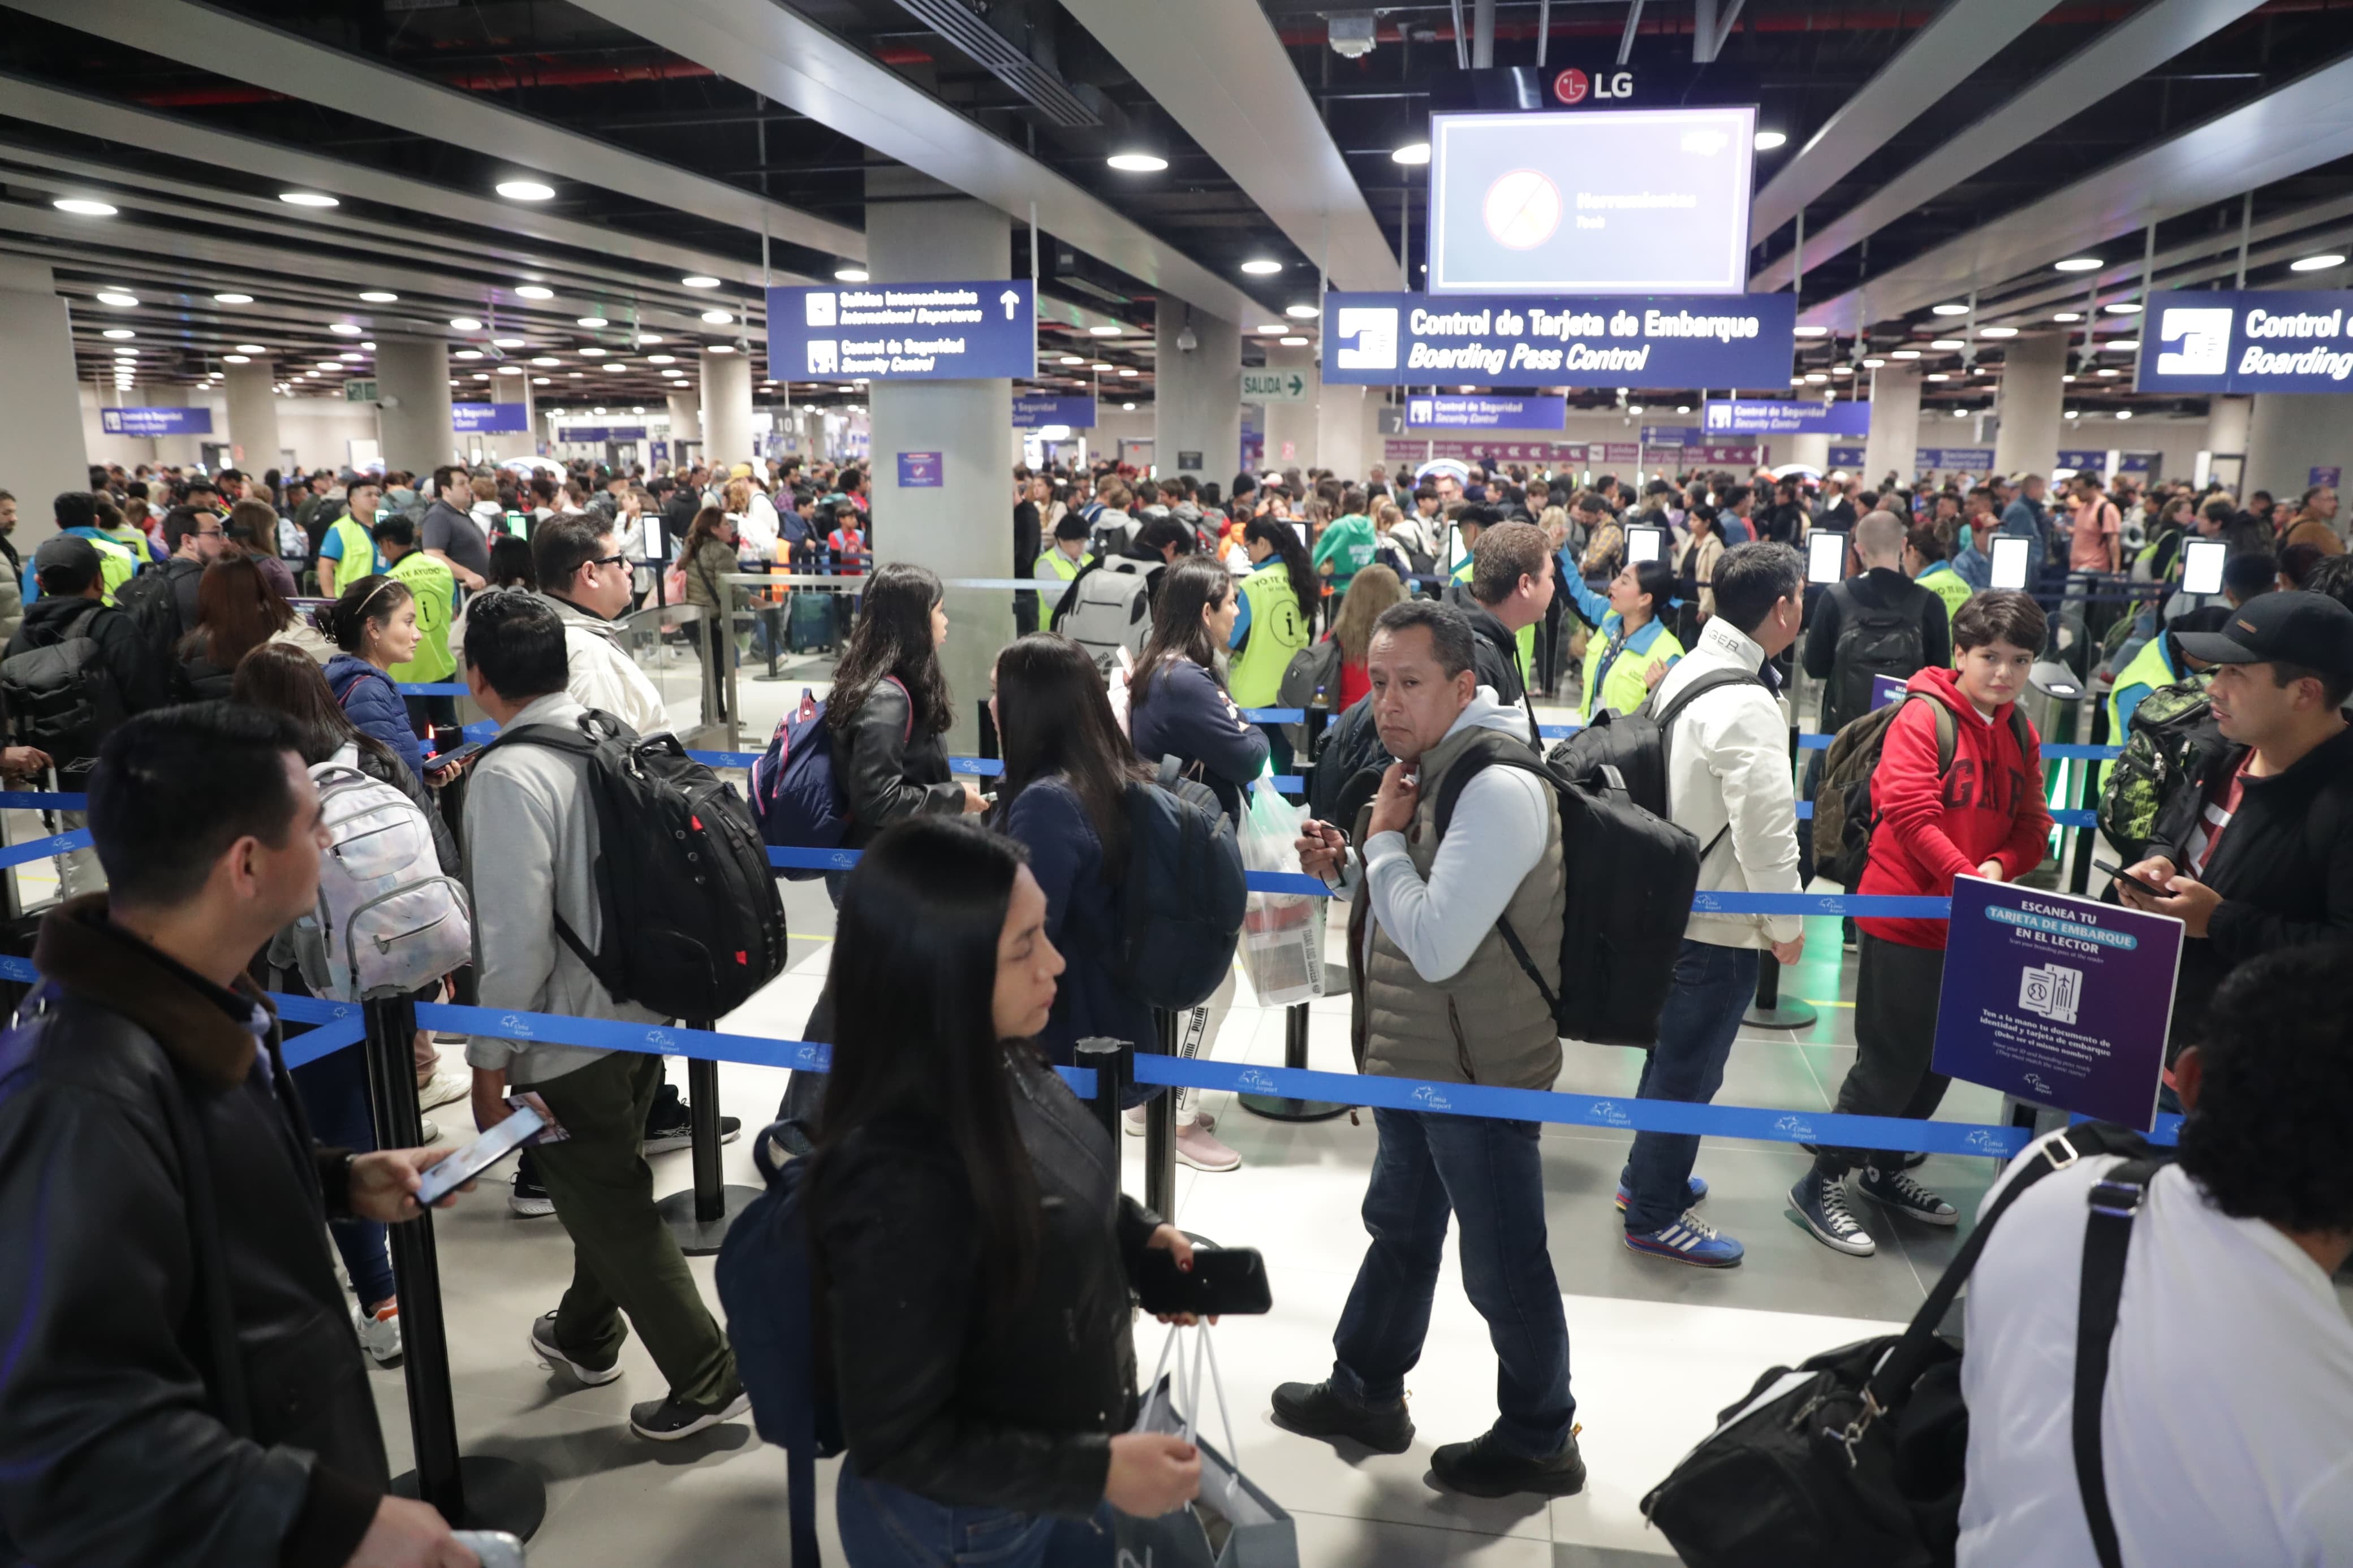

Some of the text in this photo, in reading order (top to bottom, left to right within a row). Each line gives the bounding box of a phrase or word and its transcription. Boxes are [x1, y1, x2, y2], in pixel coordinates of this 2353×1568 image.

[1594, 72, 1633, 98] LG
[840, 290, 978, 308] Salidas Internacionales
[840, 308, 982, 326] International Departures
[1410, 309, 1759, 343] Control de Tarjeta de Embarque
[2246, 309, 2342, 338] Control
[841, 338, 964, 356] Control de Seguridad
[841, 356, 935, 375] Security Control
[1408, 343, 1650, 375] Boarding Pass Control
[2238, 346, 2353, 381] Boarding
[1244, 377, 1282, 394] SALIDA
[1018, 402, 1057, 413] Seguridad
[1435, 401, 1523, 413] Control de Seguridad
[1734, 405, 1826, 418] Control de Seguridad
[777, 417, 792, 433] 10
[1393, 417, 1401, 433] 7
[1434, 413, 1498, 424] Security Control
[1734, 418, 1802, 430] Security Control
[1254, 578, 1268, 587] YO
[1943, 758, 2026, 819] GAP
[2021, 901, 2096, 925] ESCANEA TU
[1989, 908, 2131, 947] TARJETA DE EMBARQUE
[2016, 927, 2099, 954] EN EL LECTOR
[2034, 943, 2057, 954] boarding
[1983, 1009, 1996, 1018] Ten
[2015, 1018, 2037, 1028] mano
[2050, 1026, 2098, 1044] documento
[1980, 1017, 2017, 1031] identidad
[2027, 1028, 2054, 1042] tarjeta
[2068, 1040, 2111, 1056] embarque
[1994, 1030, 2015, 1040] (Debe
[2036, 1041, 2059, 1052] mismo
[2061, 1046, 2092, 1061] nombre)
